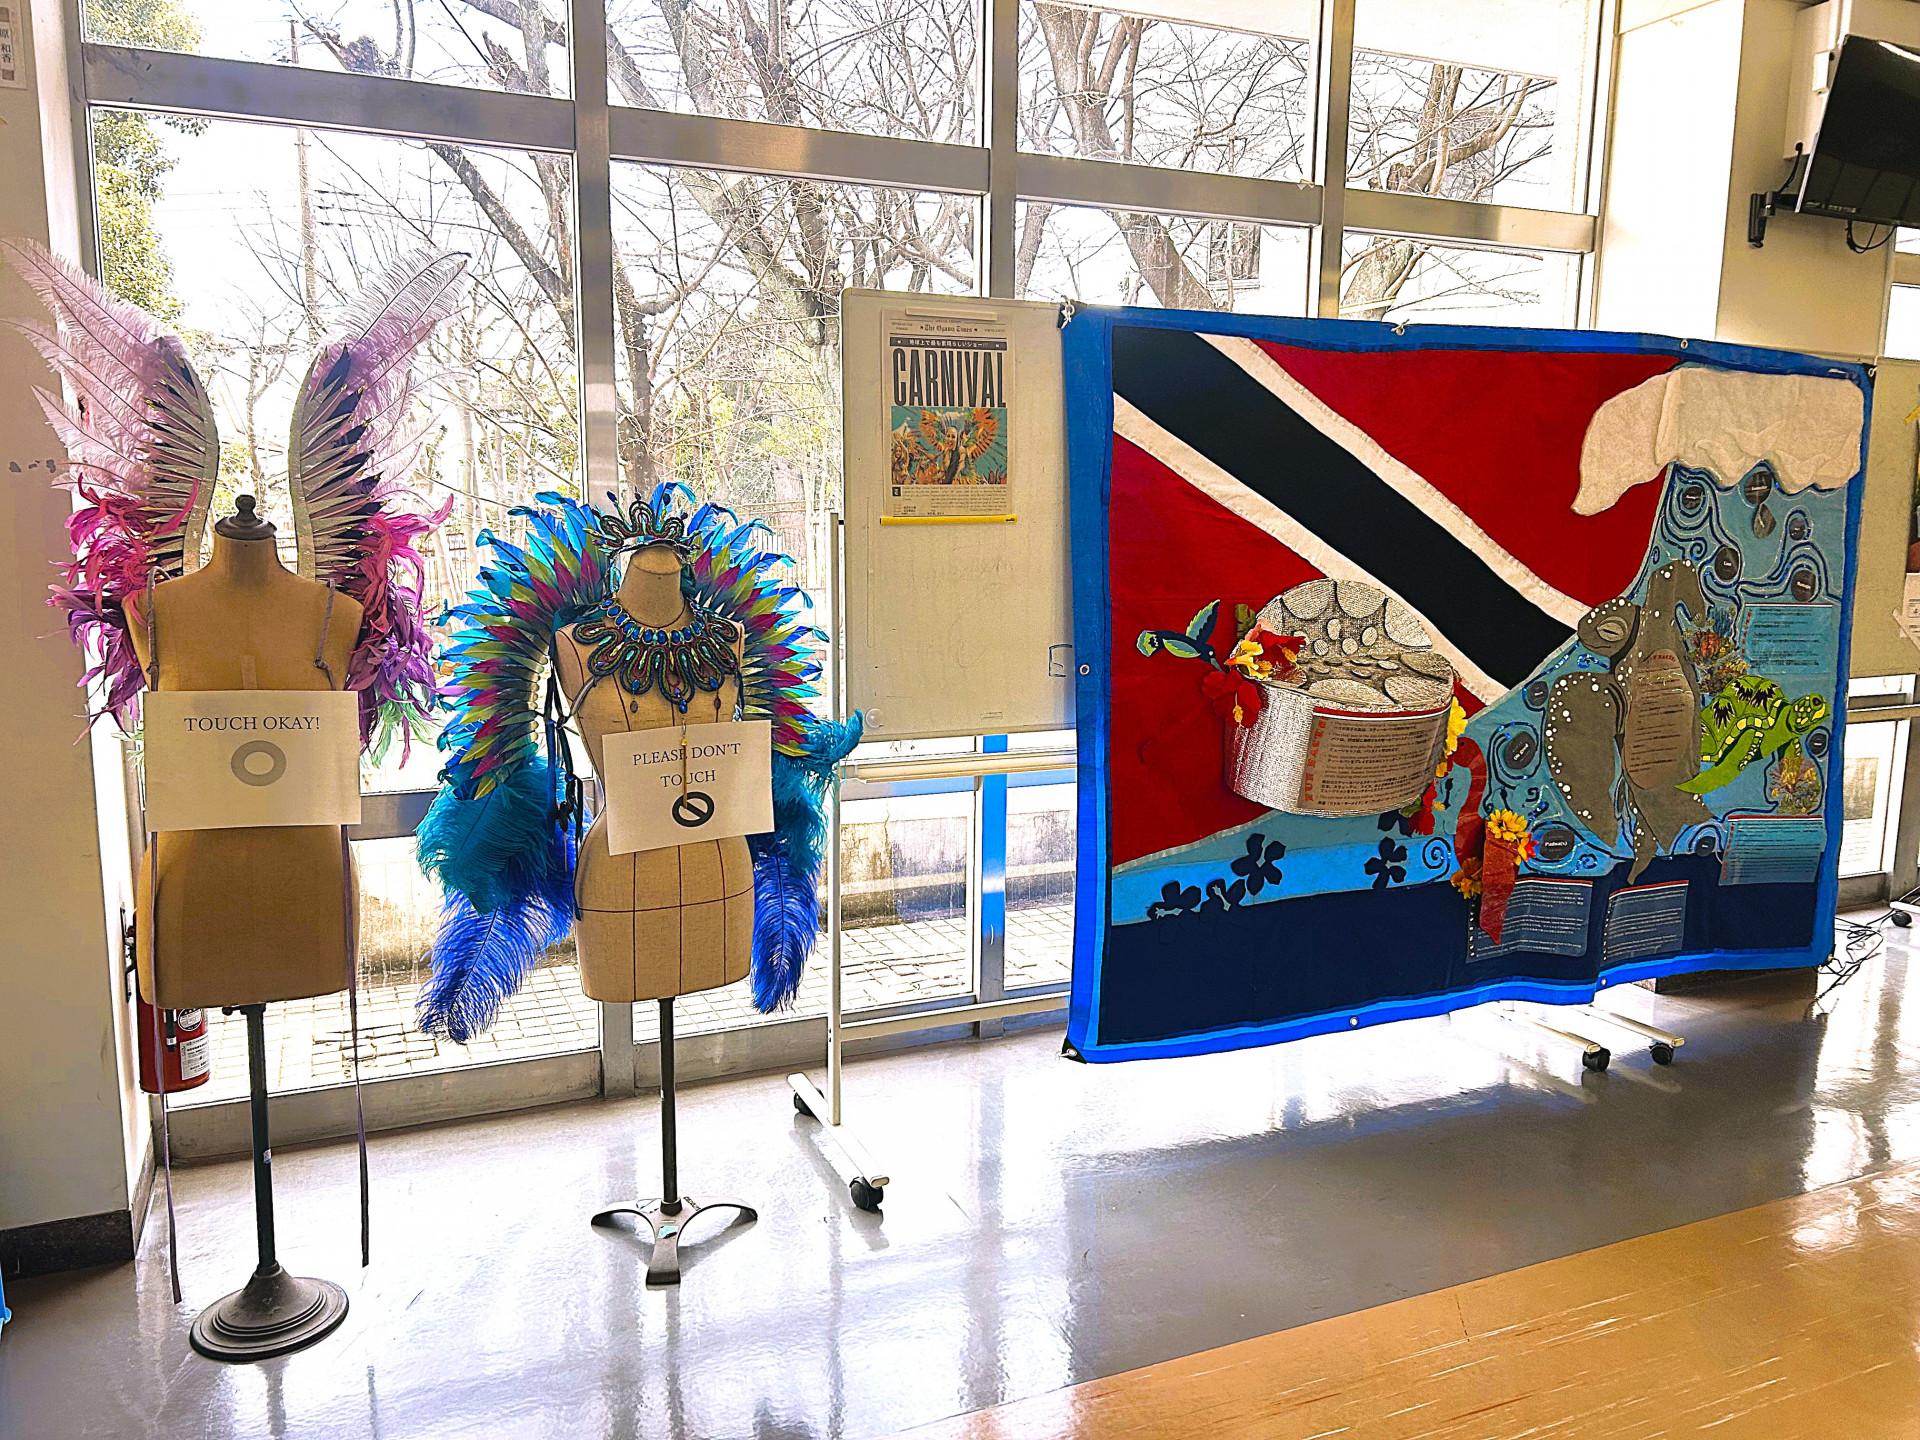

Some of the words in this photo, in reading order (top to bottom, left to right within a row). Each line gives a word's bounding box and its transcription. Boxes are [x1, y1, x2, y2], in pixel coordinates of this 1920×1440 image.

[892, 347, 1006, 408] CARNIVAL
[183, 716, 257, 731] TOUCH
[263, 716, 320, 730] OKAY!
[632, 749, 688, 766] PLEASE
[691, 742, 741, 758] DON'T
